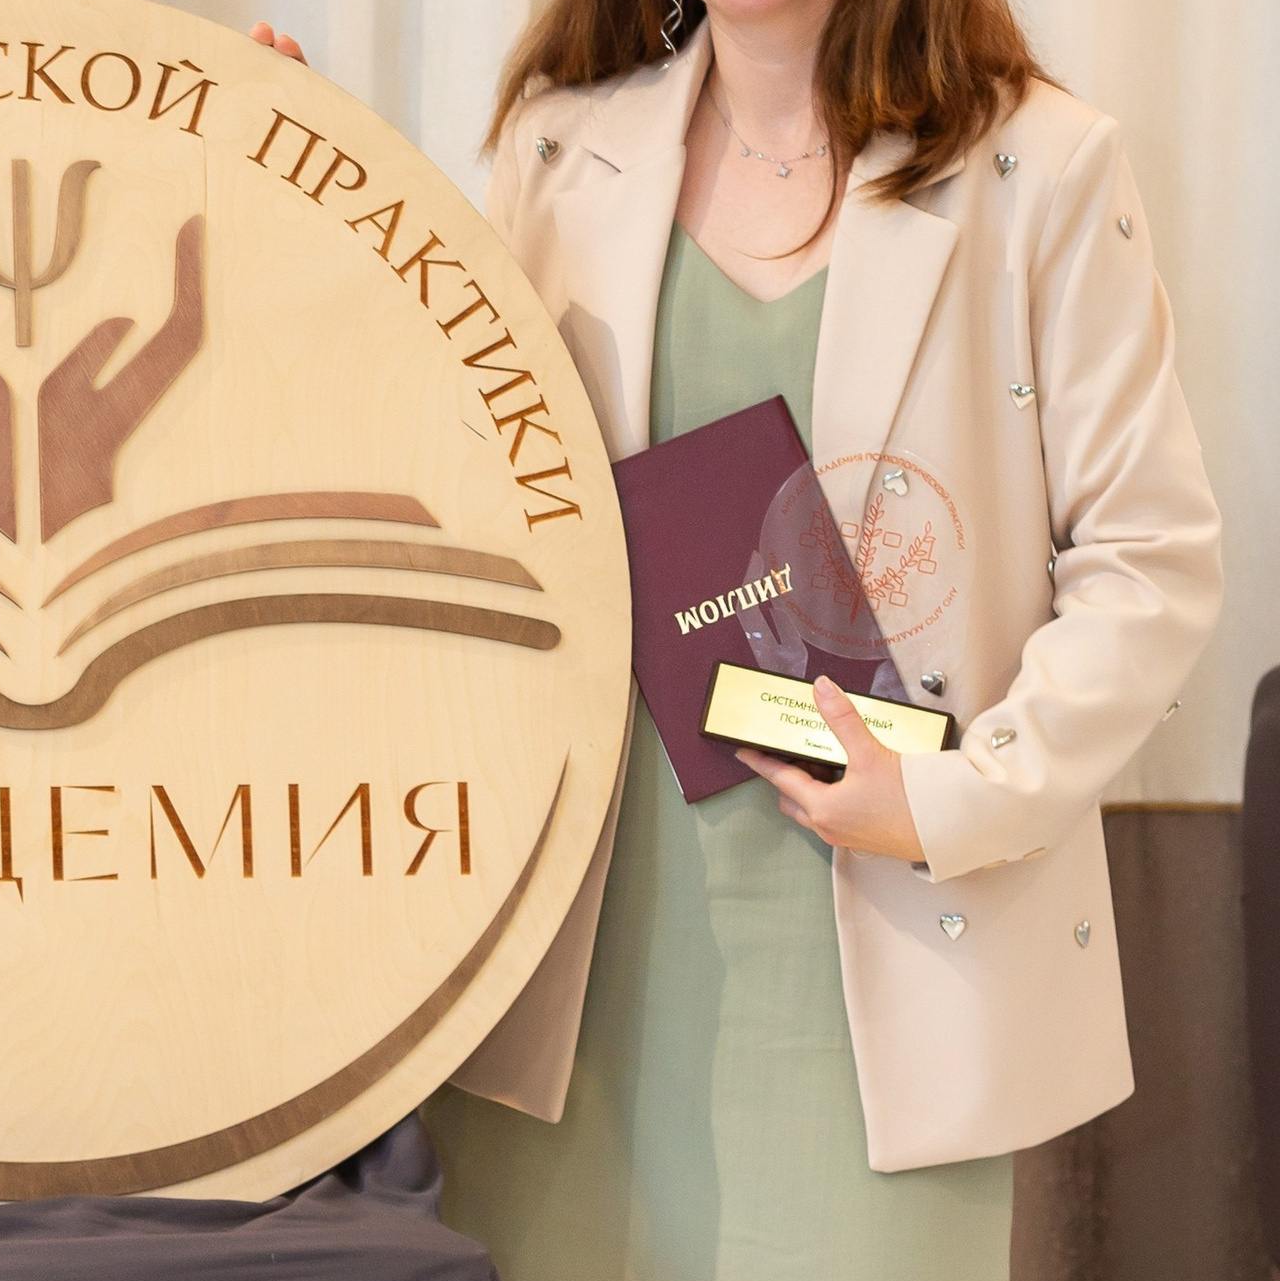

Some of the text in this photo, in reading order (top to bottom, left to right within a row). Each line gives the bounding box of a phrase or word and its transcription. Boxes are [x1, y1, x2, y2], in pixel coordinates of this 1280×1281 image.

[245, 107, 583, 534] ПРАКТИКИ
[813, 452, 863, 477] АКАДЕМИЯ
[674, 562, 793, 635] ДИПЛОМ
[942, 586, 959, 608] АНО
[924, 605, 944, 626] ДПО
[779, 713, 831, 732] ПСИХОТЕ
